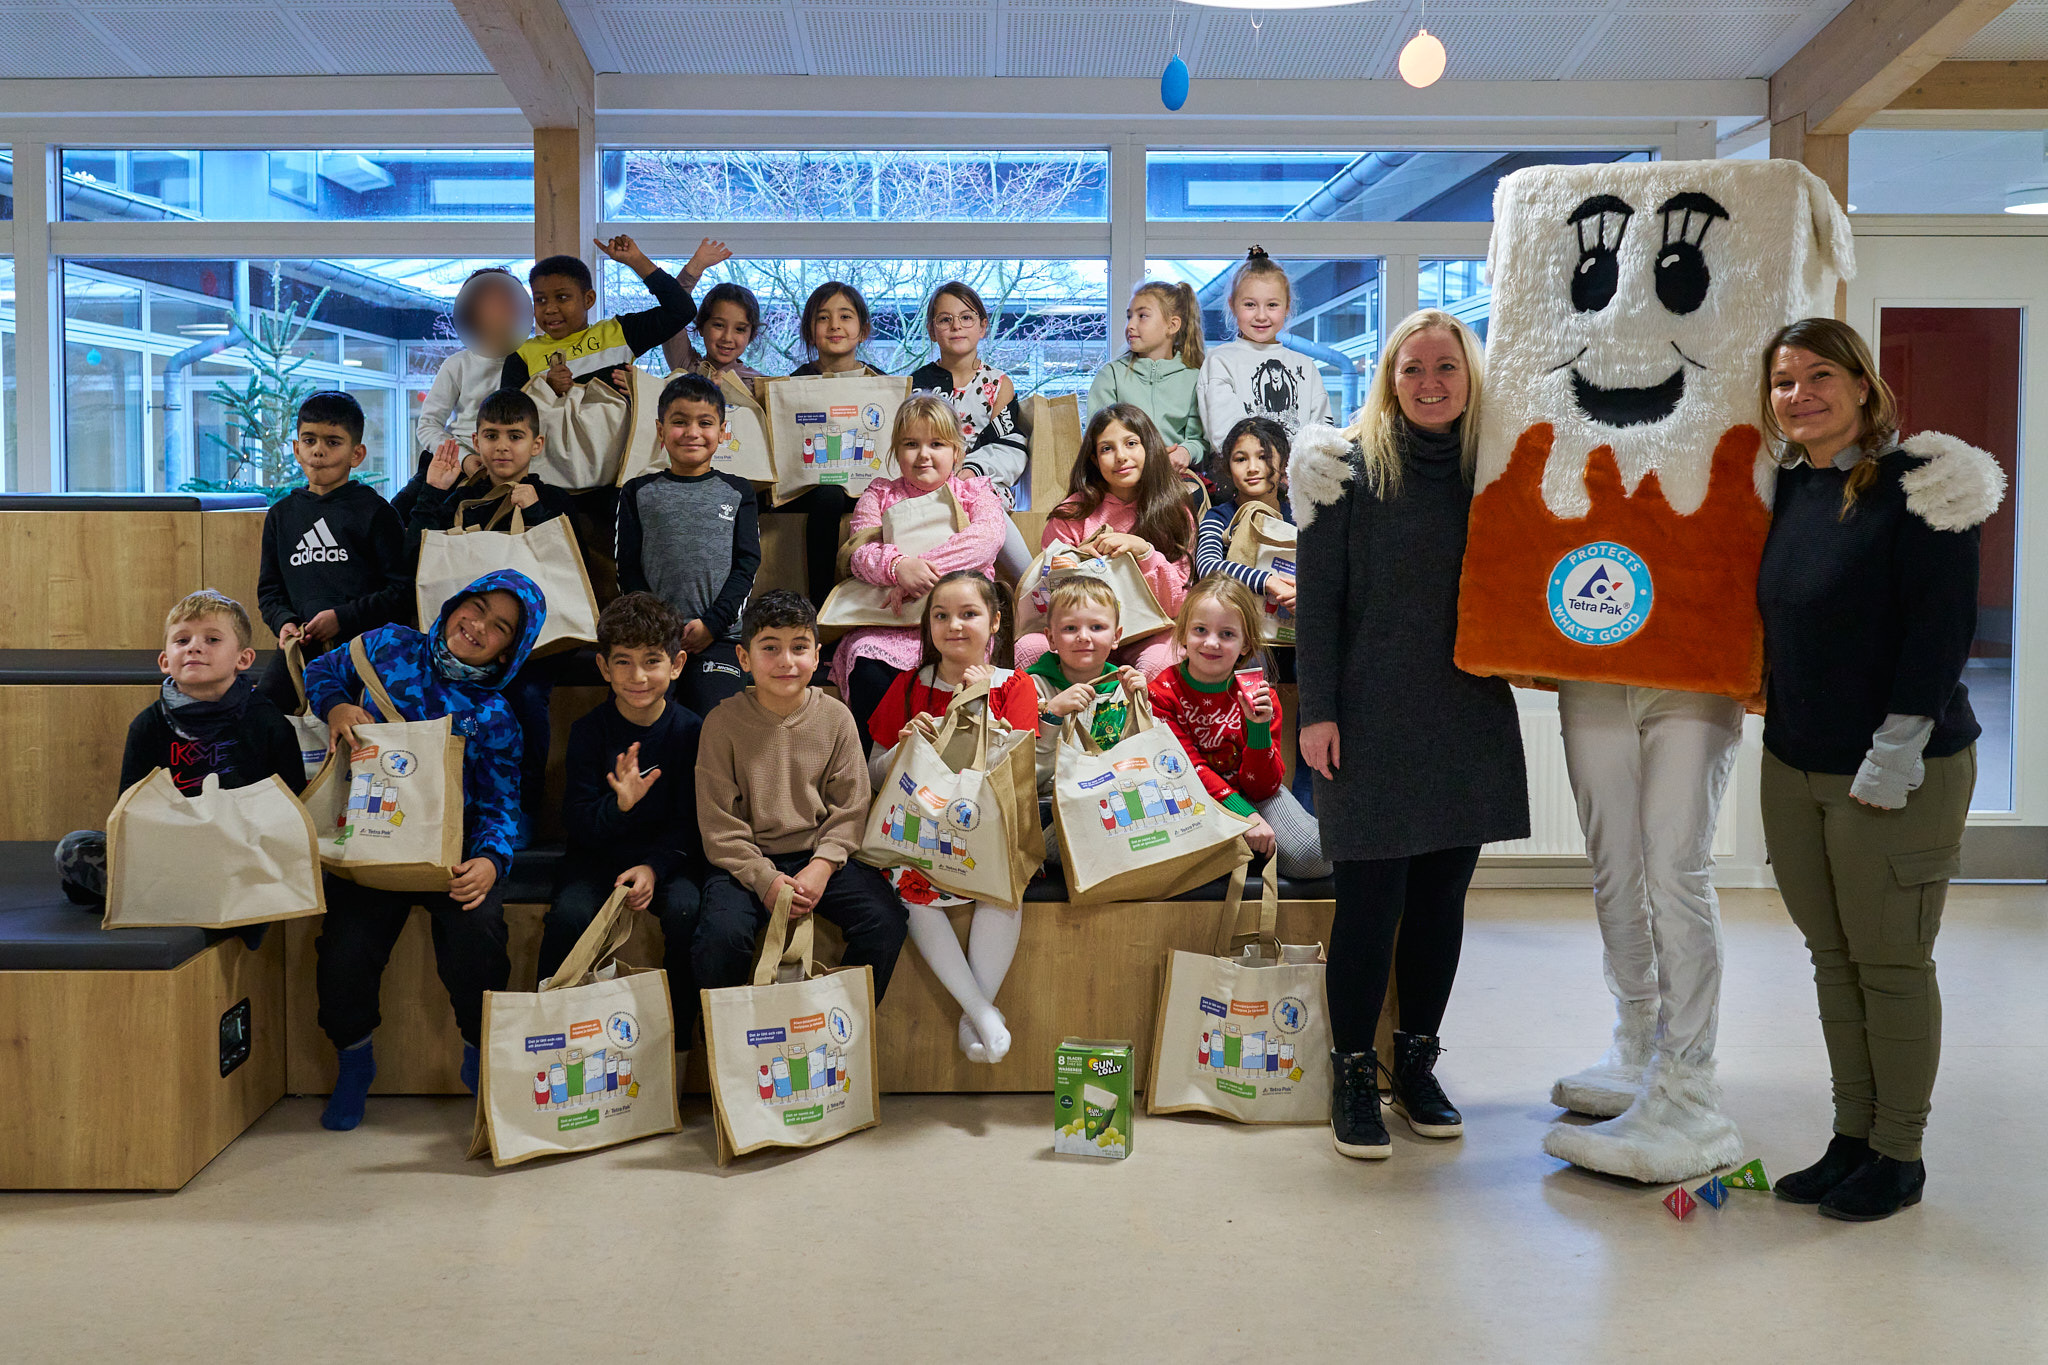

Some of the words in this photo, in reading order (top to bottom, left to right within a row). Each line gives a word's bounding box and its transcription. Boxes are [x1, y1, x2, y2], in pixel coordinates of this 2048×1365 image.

[543, 336, 600, 367] KNG
[289, 546, 349, 566] adidas
[1568, 545, 1642, 573] PROTECTS
[1568, 598, 1598, 613] Tetra
[1599, 602, 1623, 616] Pak
[1553, 604, 1595, 641] WHAT'S
[1599, 613, 1640, 641] GOOD
[1057, 1055, 1066, 1065] 8
[1092, 1059, 1114, 1071] SUN
[1097, 1064, 1123, 1076] LOLLY
